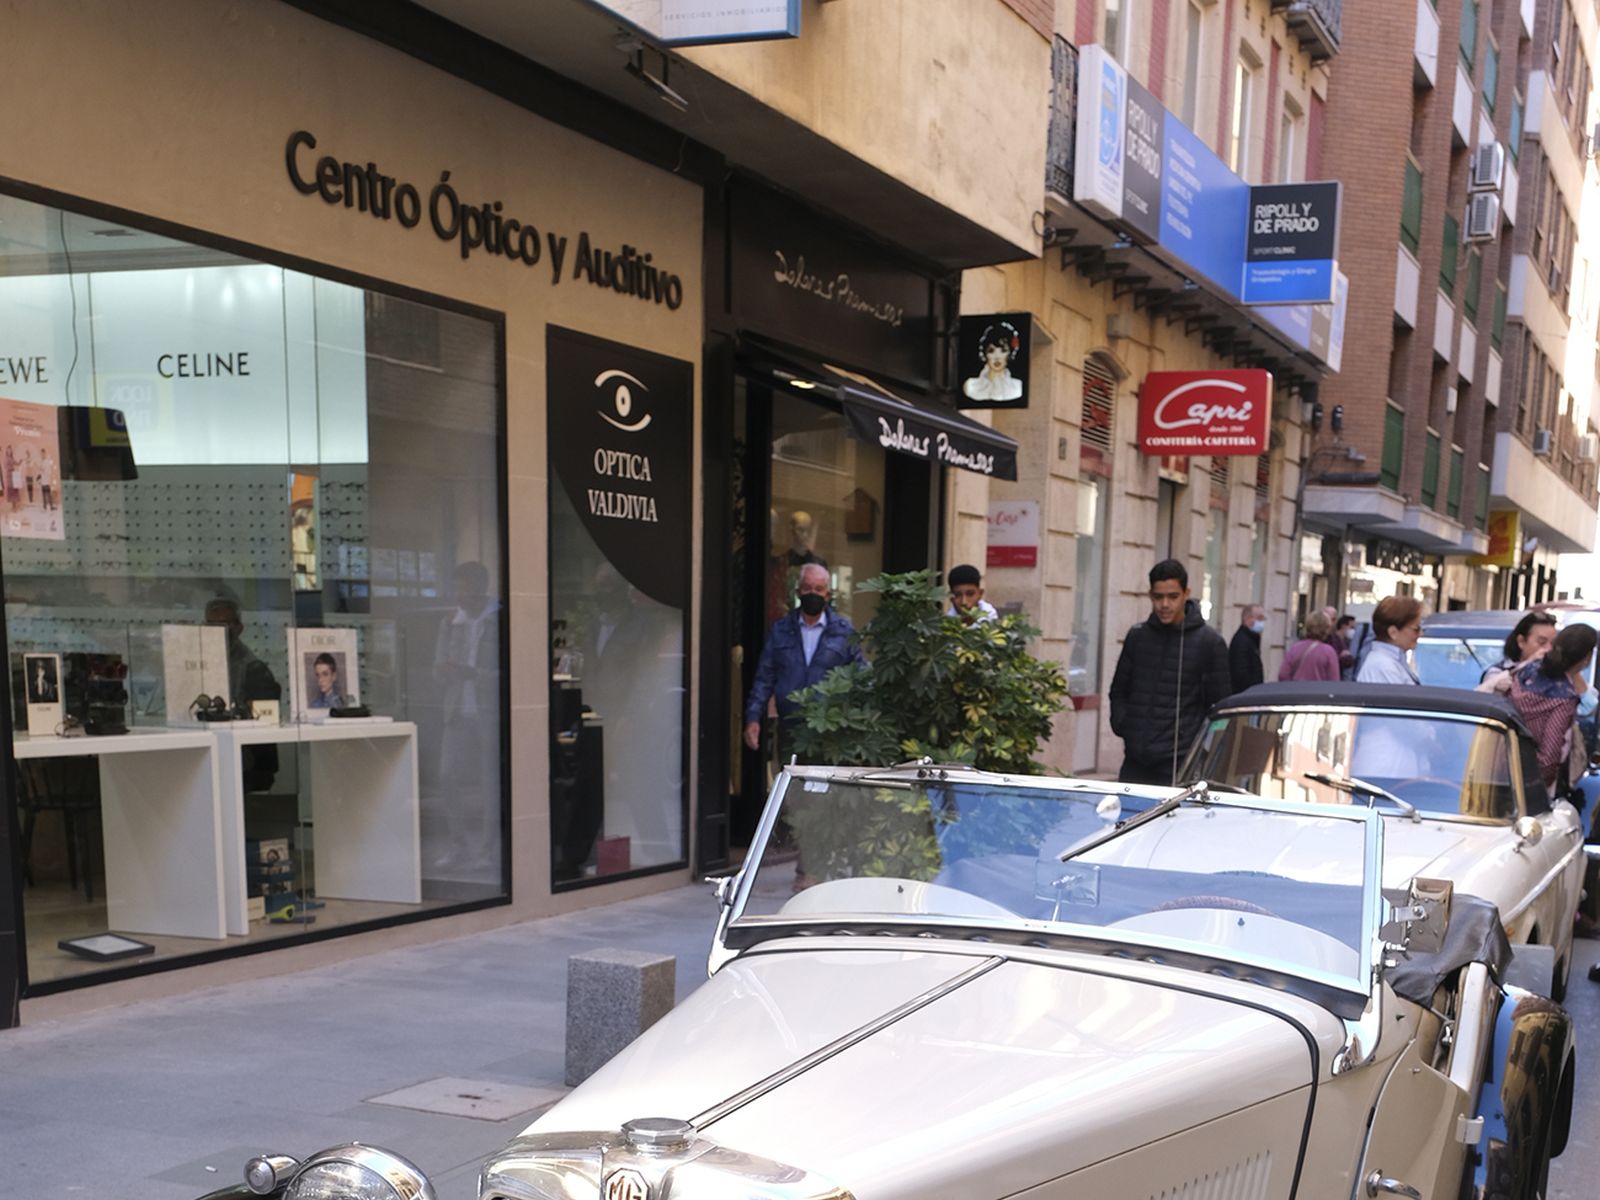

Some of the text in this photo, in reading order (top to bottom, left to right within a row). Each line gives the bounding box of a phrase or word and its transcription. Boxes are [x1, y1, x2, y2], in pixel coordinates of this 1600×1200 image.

[664, 11, 712, 21] SERVICIOS
[285, 130, 683, 311] Centro Óptico y Auditivo
[1254, 203, 1312, 220] RIPOLL Y
[1253, 217, 1320, 234] DE PRADO
[157, 352, 250, 379] CELINE
[1153, 378, 1253, 430] Capri
[878, 416, 931, 457] Dolores
[594, 447, 652, 482] OPTICA
[587, 489, 658, 522] VALDIVIA
[311, 634, 336, 646] DIOR
[185, 660, 209, 671] DIOR
